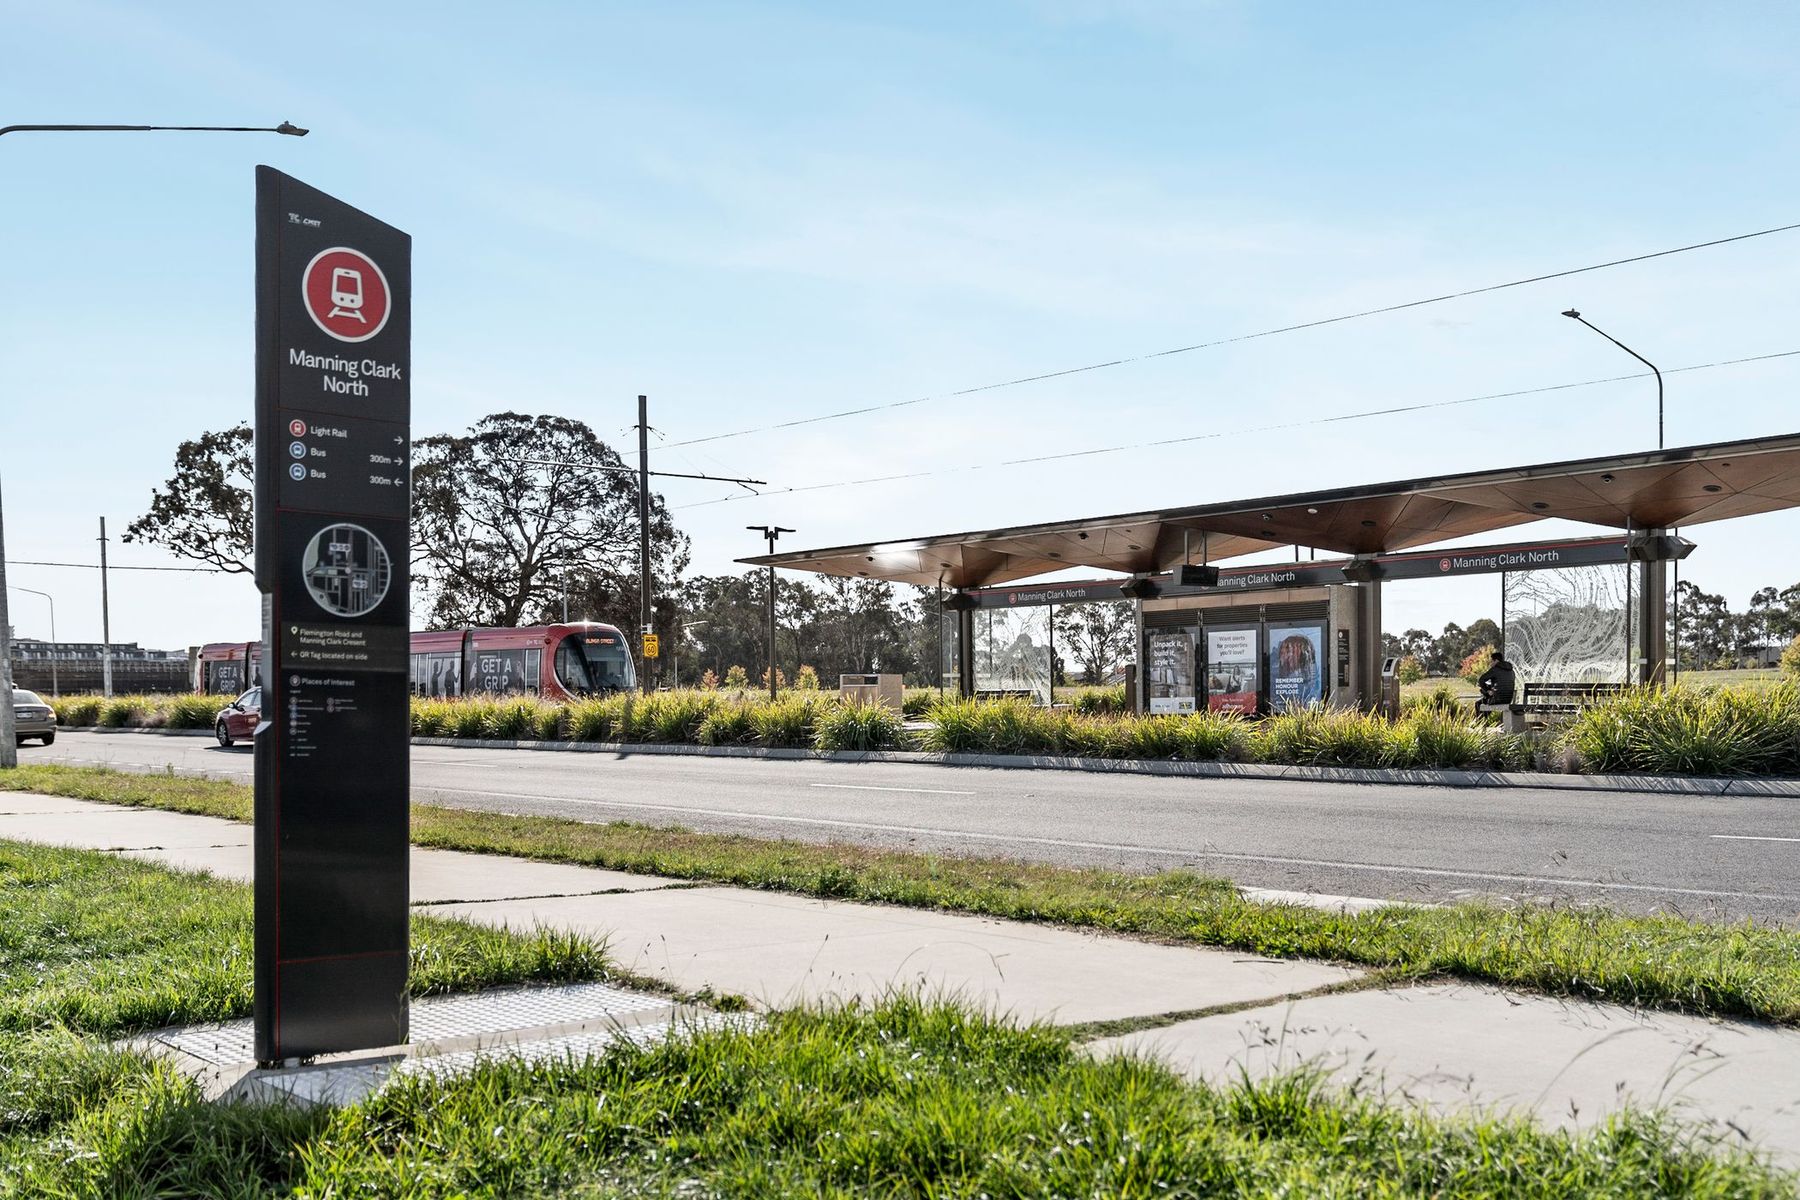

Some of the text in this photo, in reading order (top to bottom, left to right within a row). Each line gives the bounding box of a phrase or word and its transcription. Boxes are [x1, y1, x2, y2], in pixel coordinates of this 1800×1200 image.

[289, 348, 401, 380] Manning Clark
[323, 375, 369, 397] North
[310, 426, 347, 438] Light Rail
[310, 447, 326, 457] Bus
[369, 454, 391, 464] 300m
[310, 469, 326, 479] Bus
[369, 475, 391, 485] 300m
[1453, 550, 1559, 568] Manning Clark North
[1217, 571, 1295, 587] anning Clark North
[1017, 588, 1086, 602] Manning Clark North
[300, 628, 334, 638] Flemington
[335, 630, 350, 638] Road
[300, 637, 326, 646] Manning
[1153, 640, 1176, 650] Unpack
[310, 651, 321, 660] Tag
[481, 658, 512, 673] GET A
[218, 666, 238, 679] GET A
[220, 679, 236, 692] GRIP
[301, 677, 323, 685] Places
[484, 675, 509, 690] GRIP
